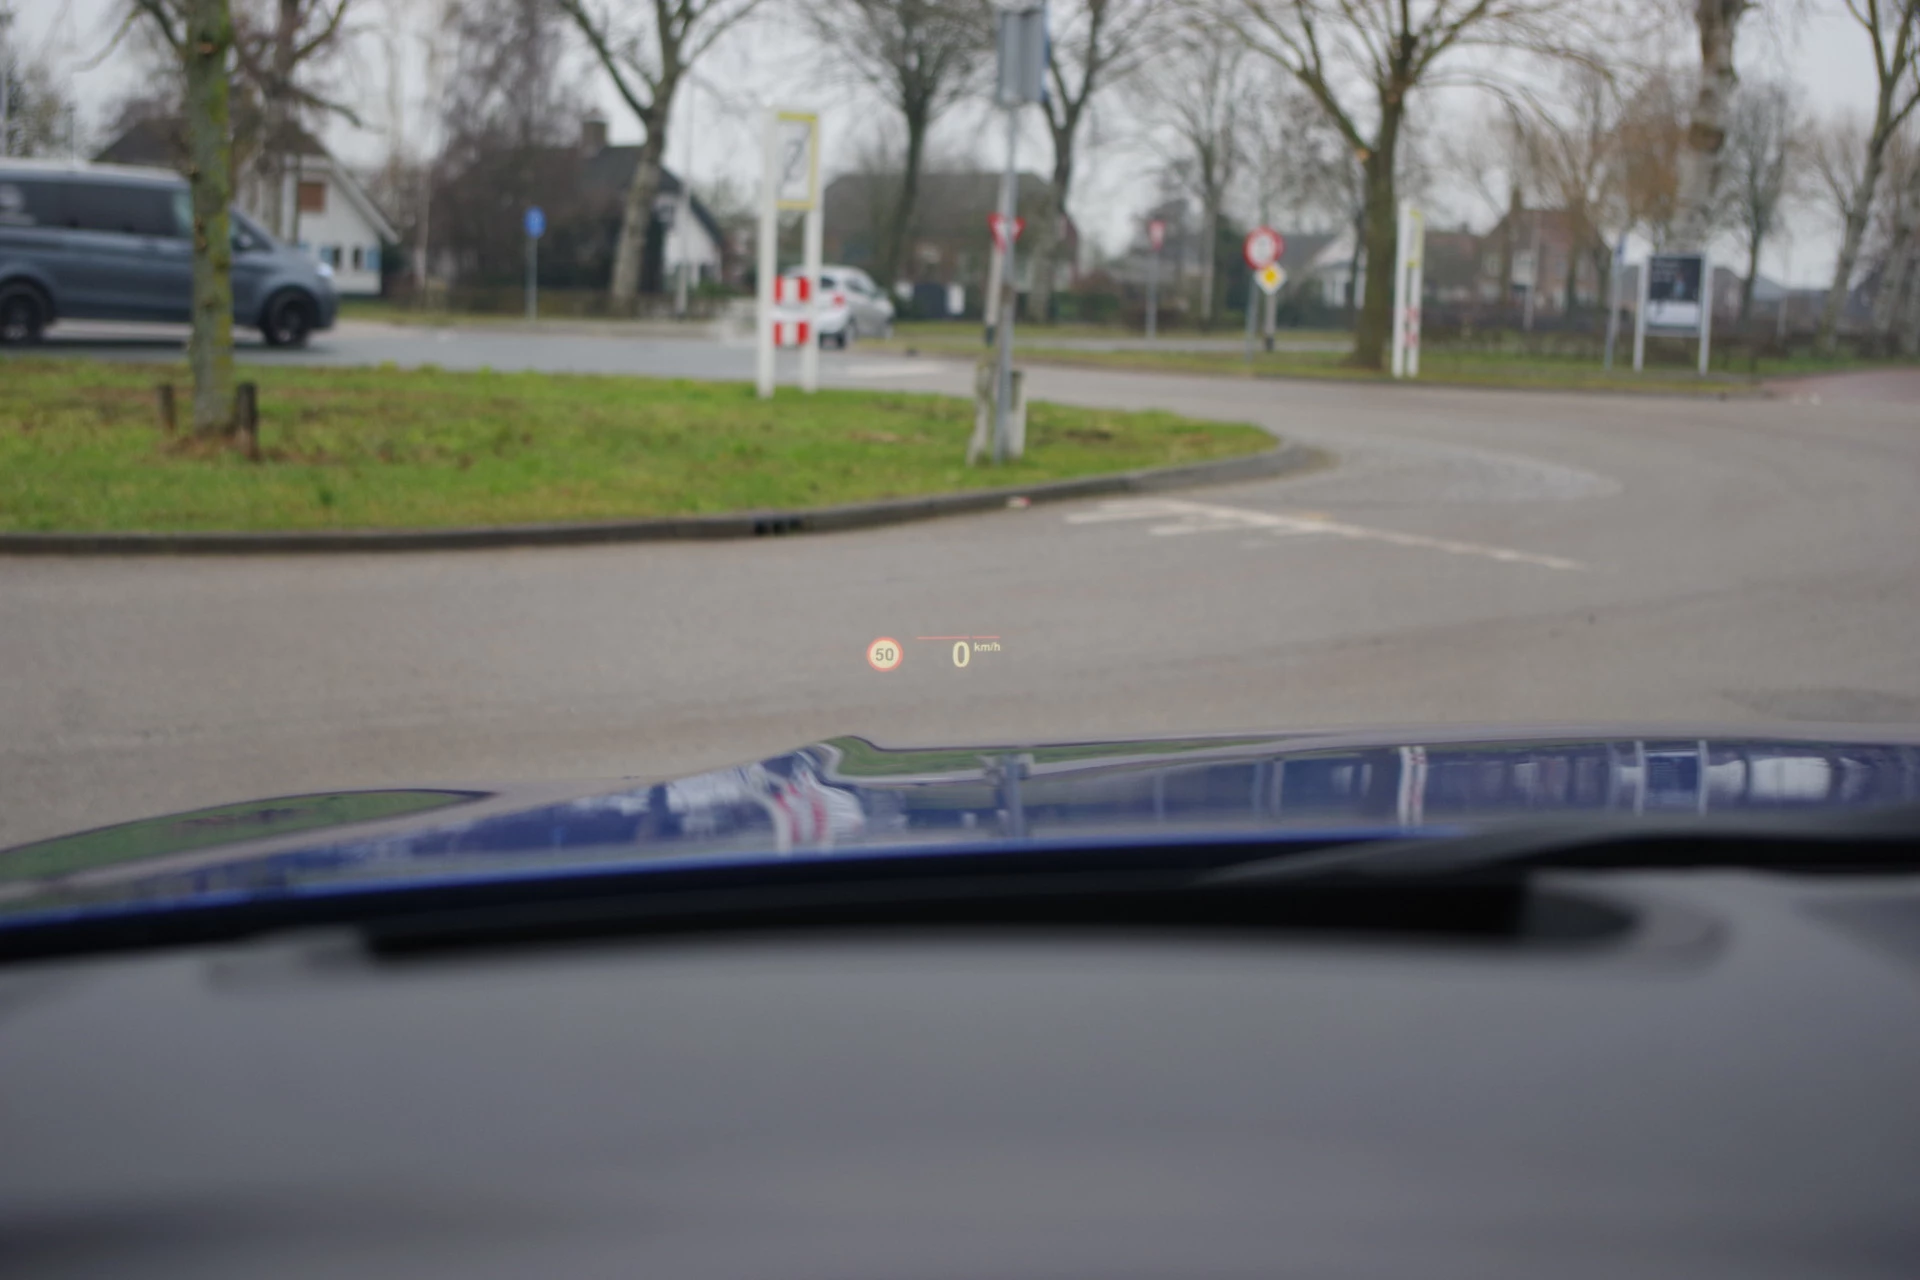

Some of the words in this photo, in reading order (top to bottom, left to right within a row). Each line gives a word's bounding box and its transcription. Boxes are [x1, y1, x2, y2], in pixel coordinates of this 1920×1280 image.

[875, 648, 894, 661] 50
[953, 641, 970, 667] 0
[974, 642, 1001, 652] km/h
